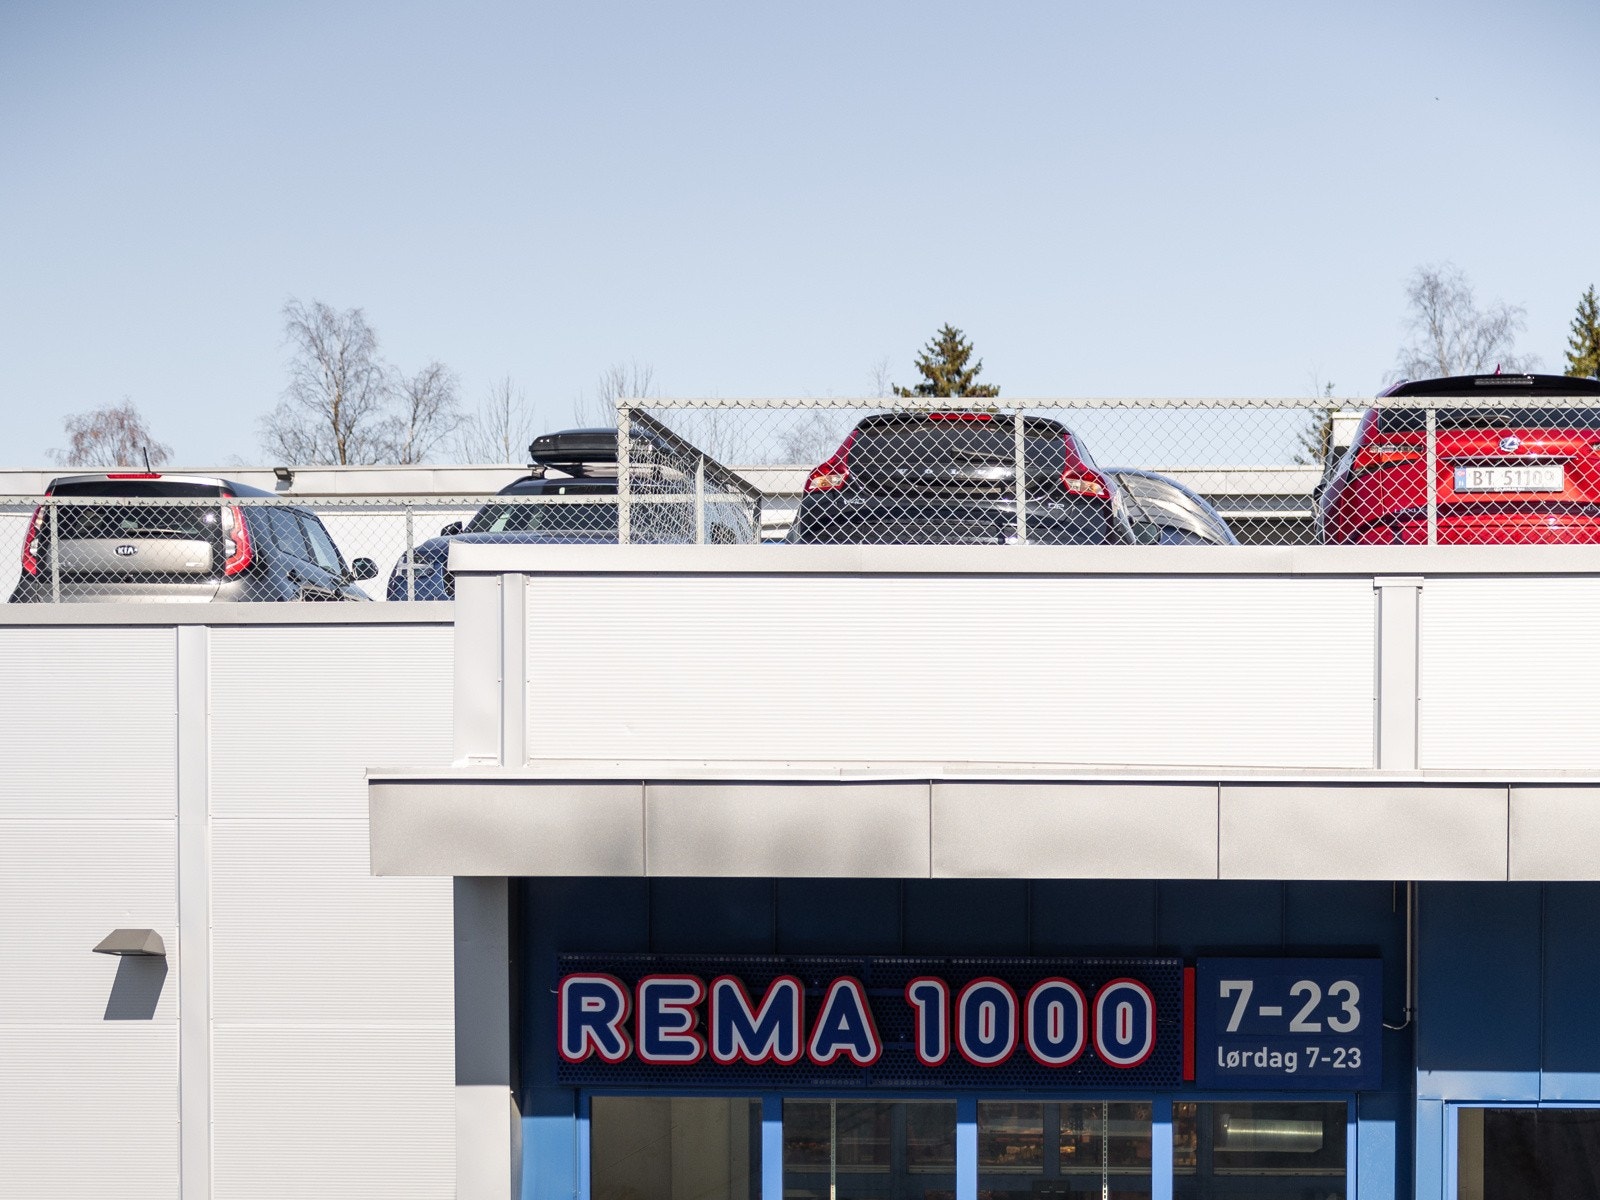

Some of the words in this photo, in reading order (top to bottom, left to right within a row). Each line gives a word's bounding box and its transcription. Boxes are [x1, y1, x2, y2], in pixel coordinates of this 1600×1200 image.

[1473, 470, 1494, 485] BT
[117, 547, 134, 555] KIA
[1219, 980, 1361, 1033] 7-23
[558, 973, 883, 1066] REMA
[905, 976, 1157, 1068] 1000
[1217, 1047, 1298, 1071] lørdag
[1305, 1047, 1362, 1069] 7-23
